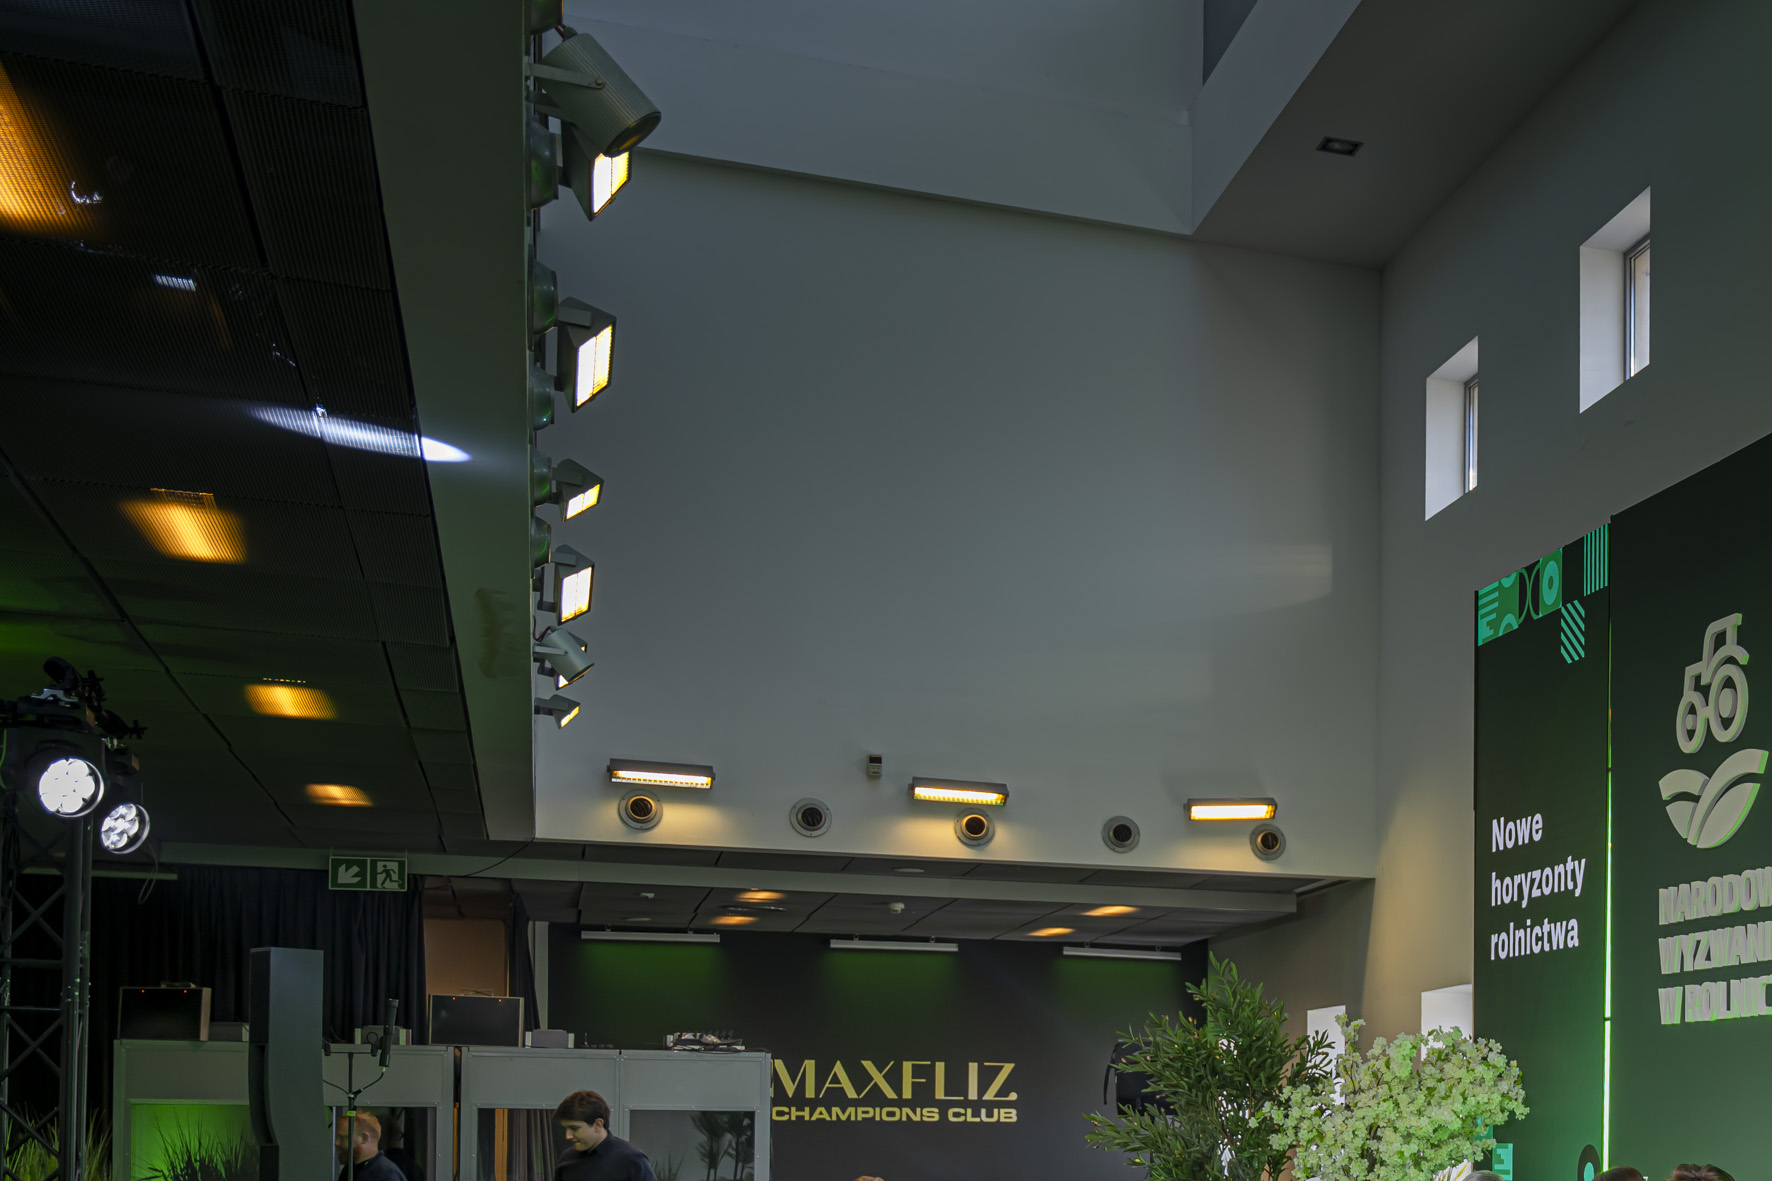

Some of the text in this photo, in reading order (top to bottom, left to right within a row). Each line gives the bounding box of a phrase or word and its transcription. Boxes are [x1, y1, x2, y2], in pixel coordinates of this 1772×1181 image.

[1492, 811, 1543, 853] Nowe
[1491, 855, 1586, 908] horyzonty
[1491, 917, 1579, 961] rolnictwa
[1659, 986, 1684, 1025] W
[771, 1059, 1018, 1100] MAXFLIZ
[772, 1106, 1018, 1123] CHAMPIONS CLUB
